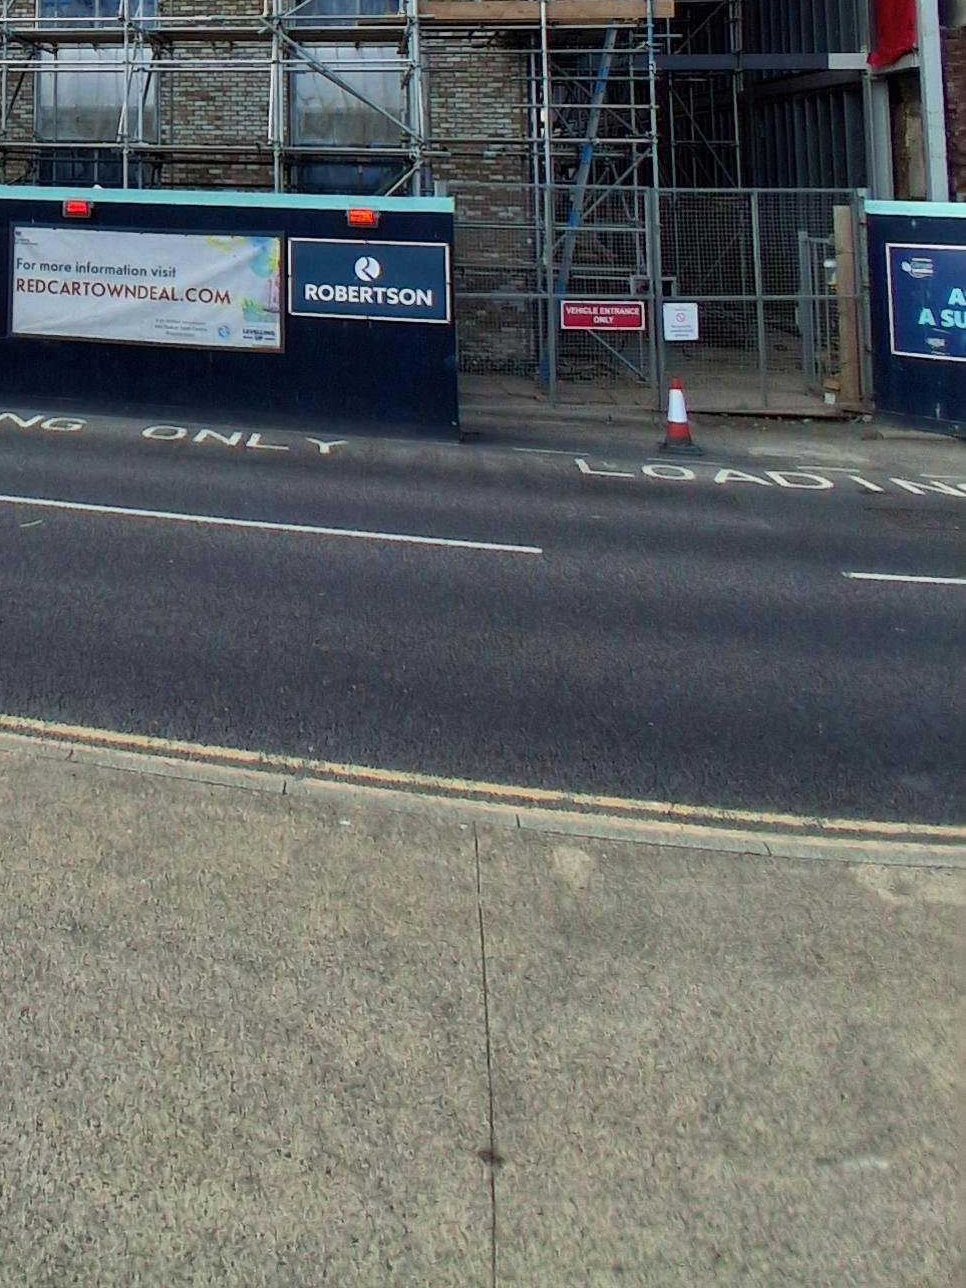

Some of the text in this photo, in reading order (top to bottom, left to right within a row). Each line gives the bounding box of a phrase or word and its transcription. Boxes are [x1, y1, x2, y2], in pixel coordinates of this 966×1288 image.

[16, 258, 177, 278] For more information visit
[16, 278, 231, 305] REDCARTOWNDEAL.COM
[304, 283, 433, 307] ROBERTSON
[565, 306, 640, 316] VEHICLE ENTRANCE
[593, 315, 614, 324] ONLY
[918, 307, 936, 326] A
[141, 424, 350, 455] ONLY
[574, 457, 966, 497] LOADIN
